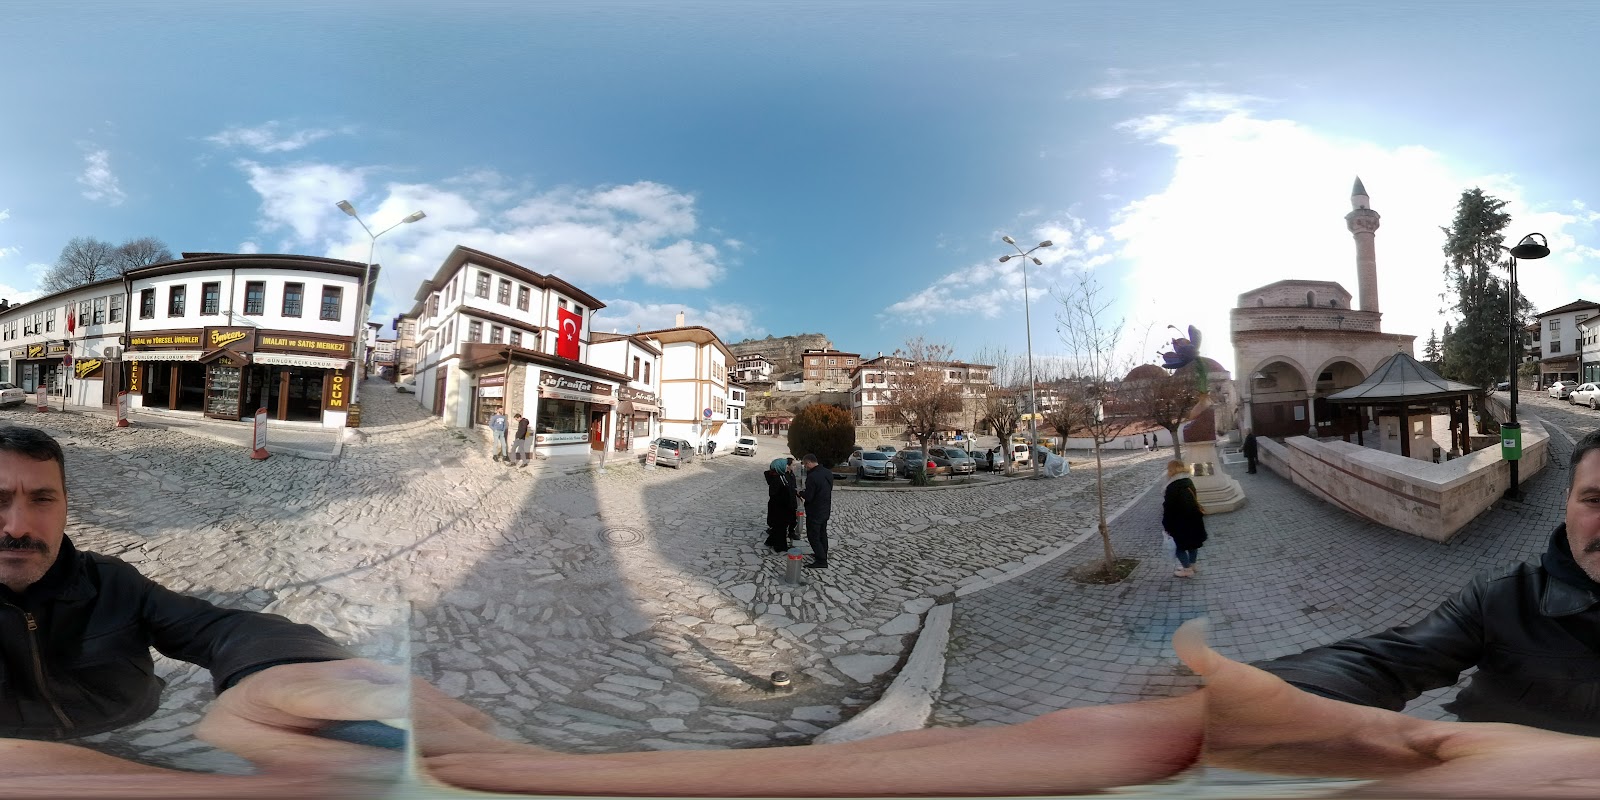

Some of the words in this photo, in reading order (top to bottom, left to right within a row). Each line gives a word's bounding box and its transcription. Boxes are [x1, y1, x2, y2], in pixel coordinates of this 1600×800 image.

[174, 335, 199, 344] ÜRÜNLER
[297, 339, 315, 349] SATIŞ
[316, 342, 345, 352] MERKEZİ
[130, 360, 139, 391] HELVA
[330, 369, 344, 407] LOKUM
